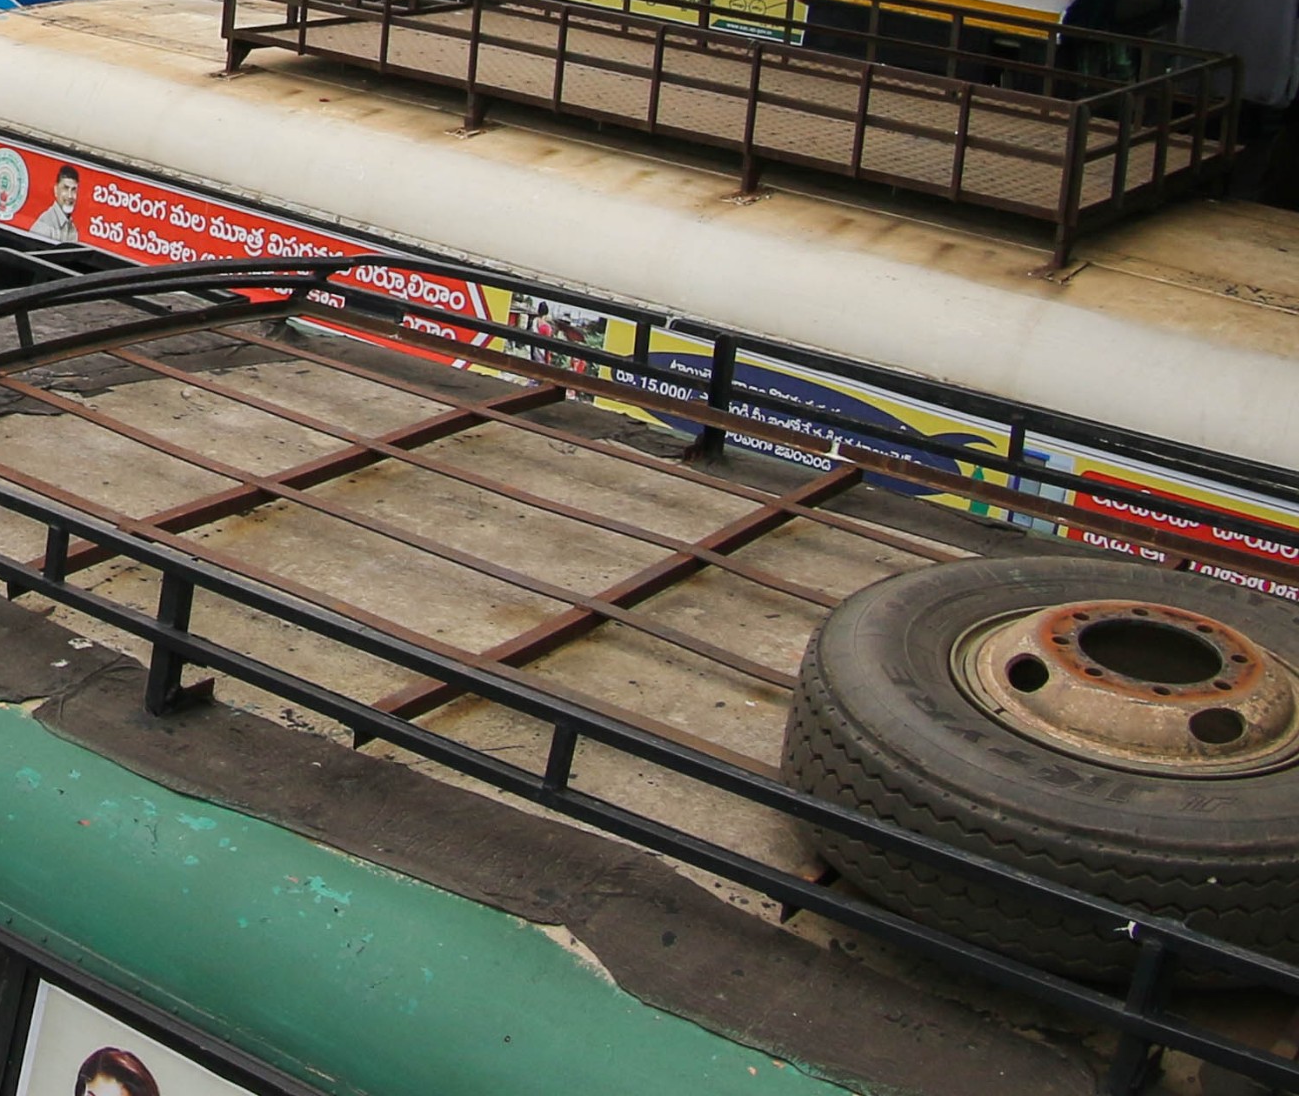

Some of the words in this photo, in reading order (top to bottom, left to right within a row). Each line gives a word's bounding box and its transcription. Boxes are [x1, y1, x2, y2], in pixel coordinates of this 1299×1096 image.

[89, 217, 124, 243] మన
[93, 183, 167, 220] బహిరంగ
[169, 204, 206, 232] మల
[209, 216, 265, 257] మూత్ర
